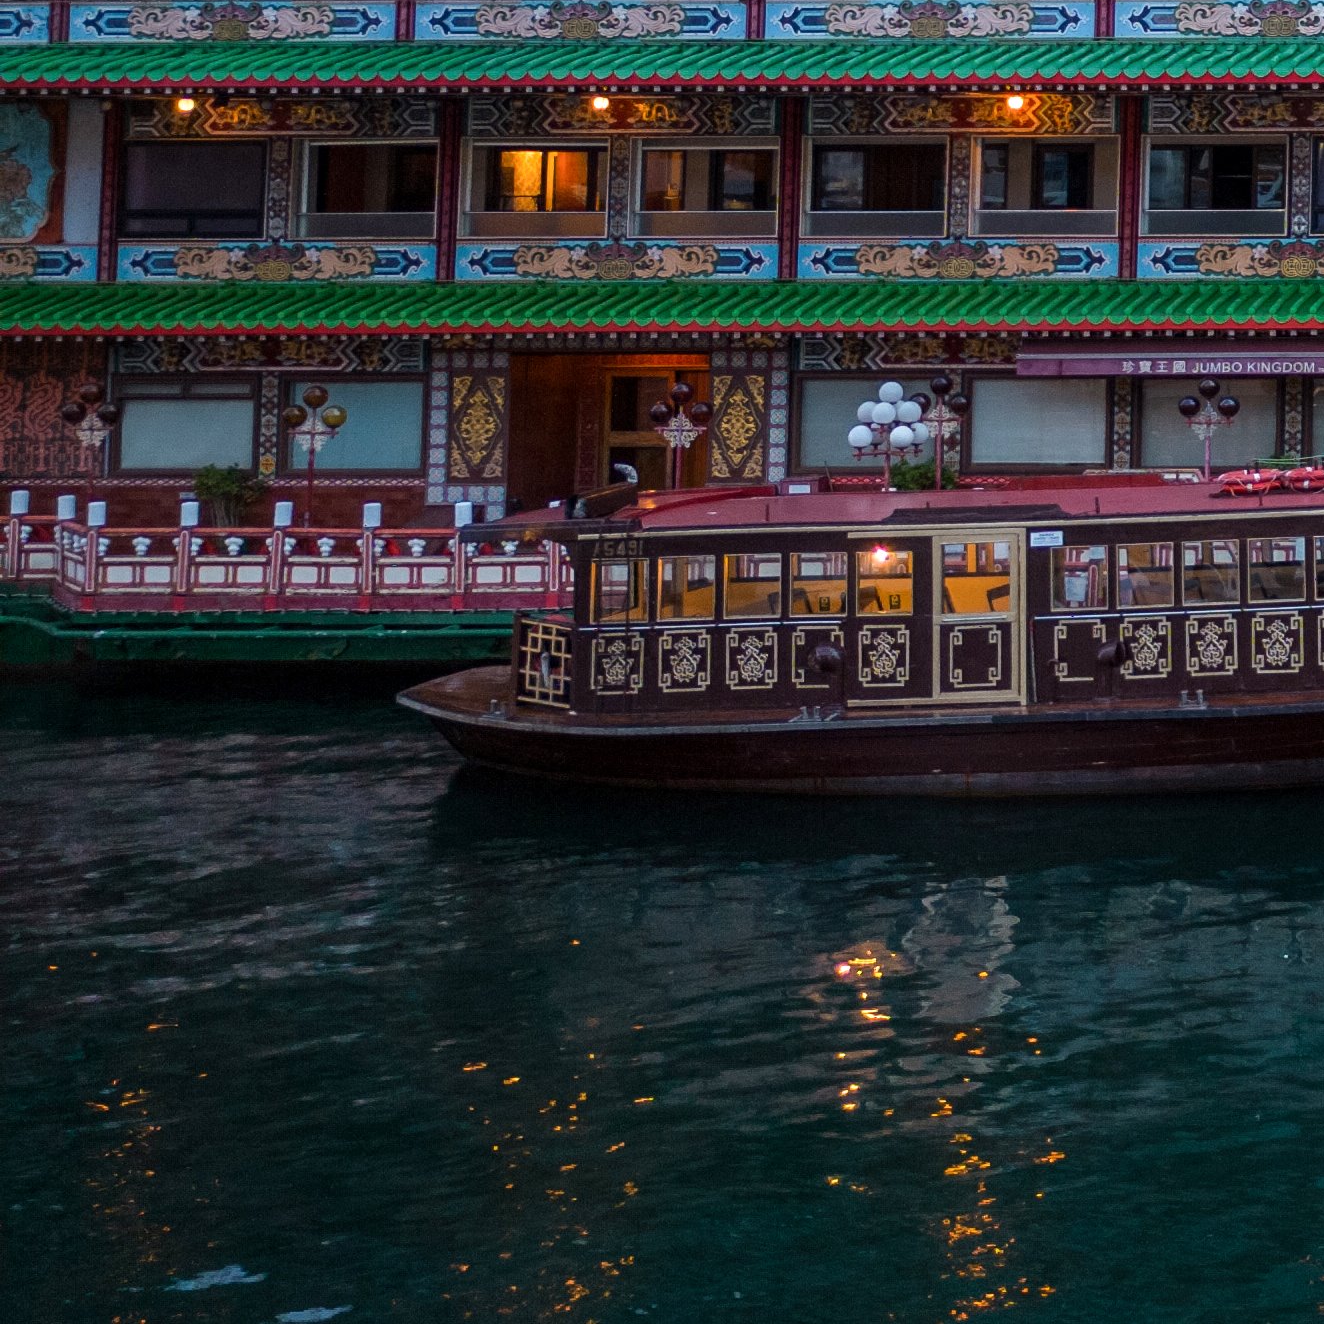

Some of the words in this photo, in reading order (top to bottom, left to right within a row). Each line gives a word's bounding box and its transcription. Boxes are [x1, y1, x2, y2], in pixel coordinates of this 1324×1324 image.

[1121, 360, 1187, 374] 珍寶王國
[1192, 361, 1243, 374] JUMBO
[1247, 361, 1315, 373] KINGDOM
